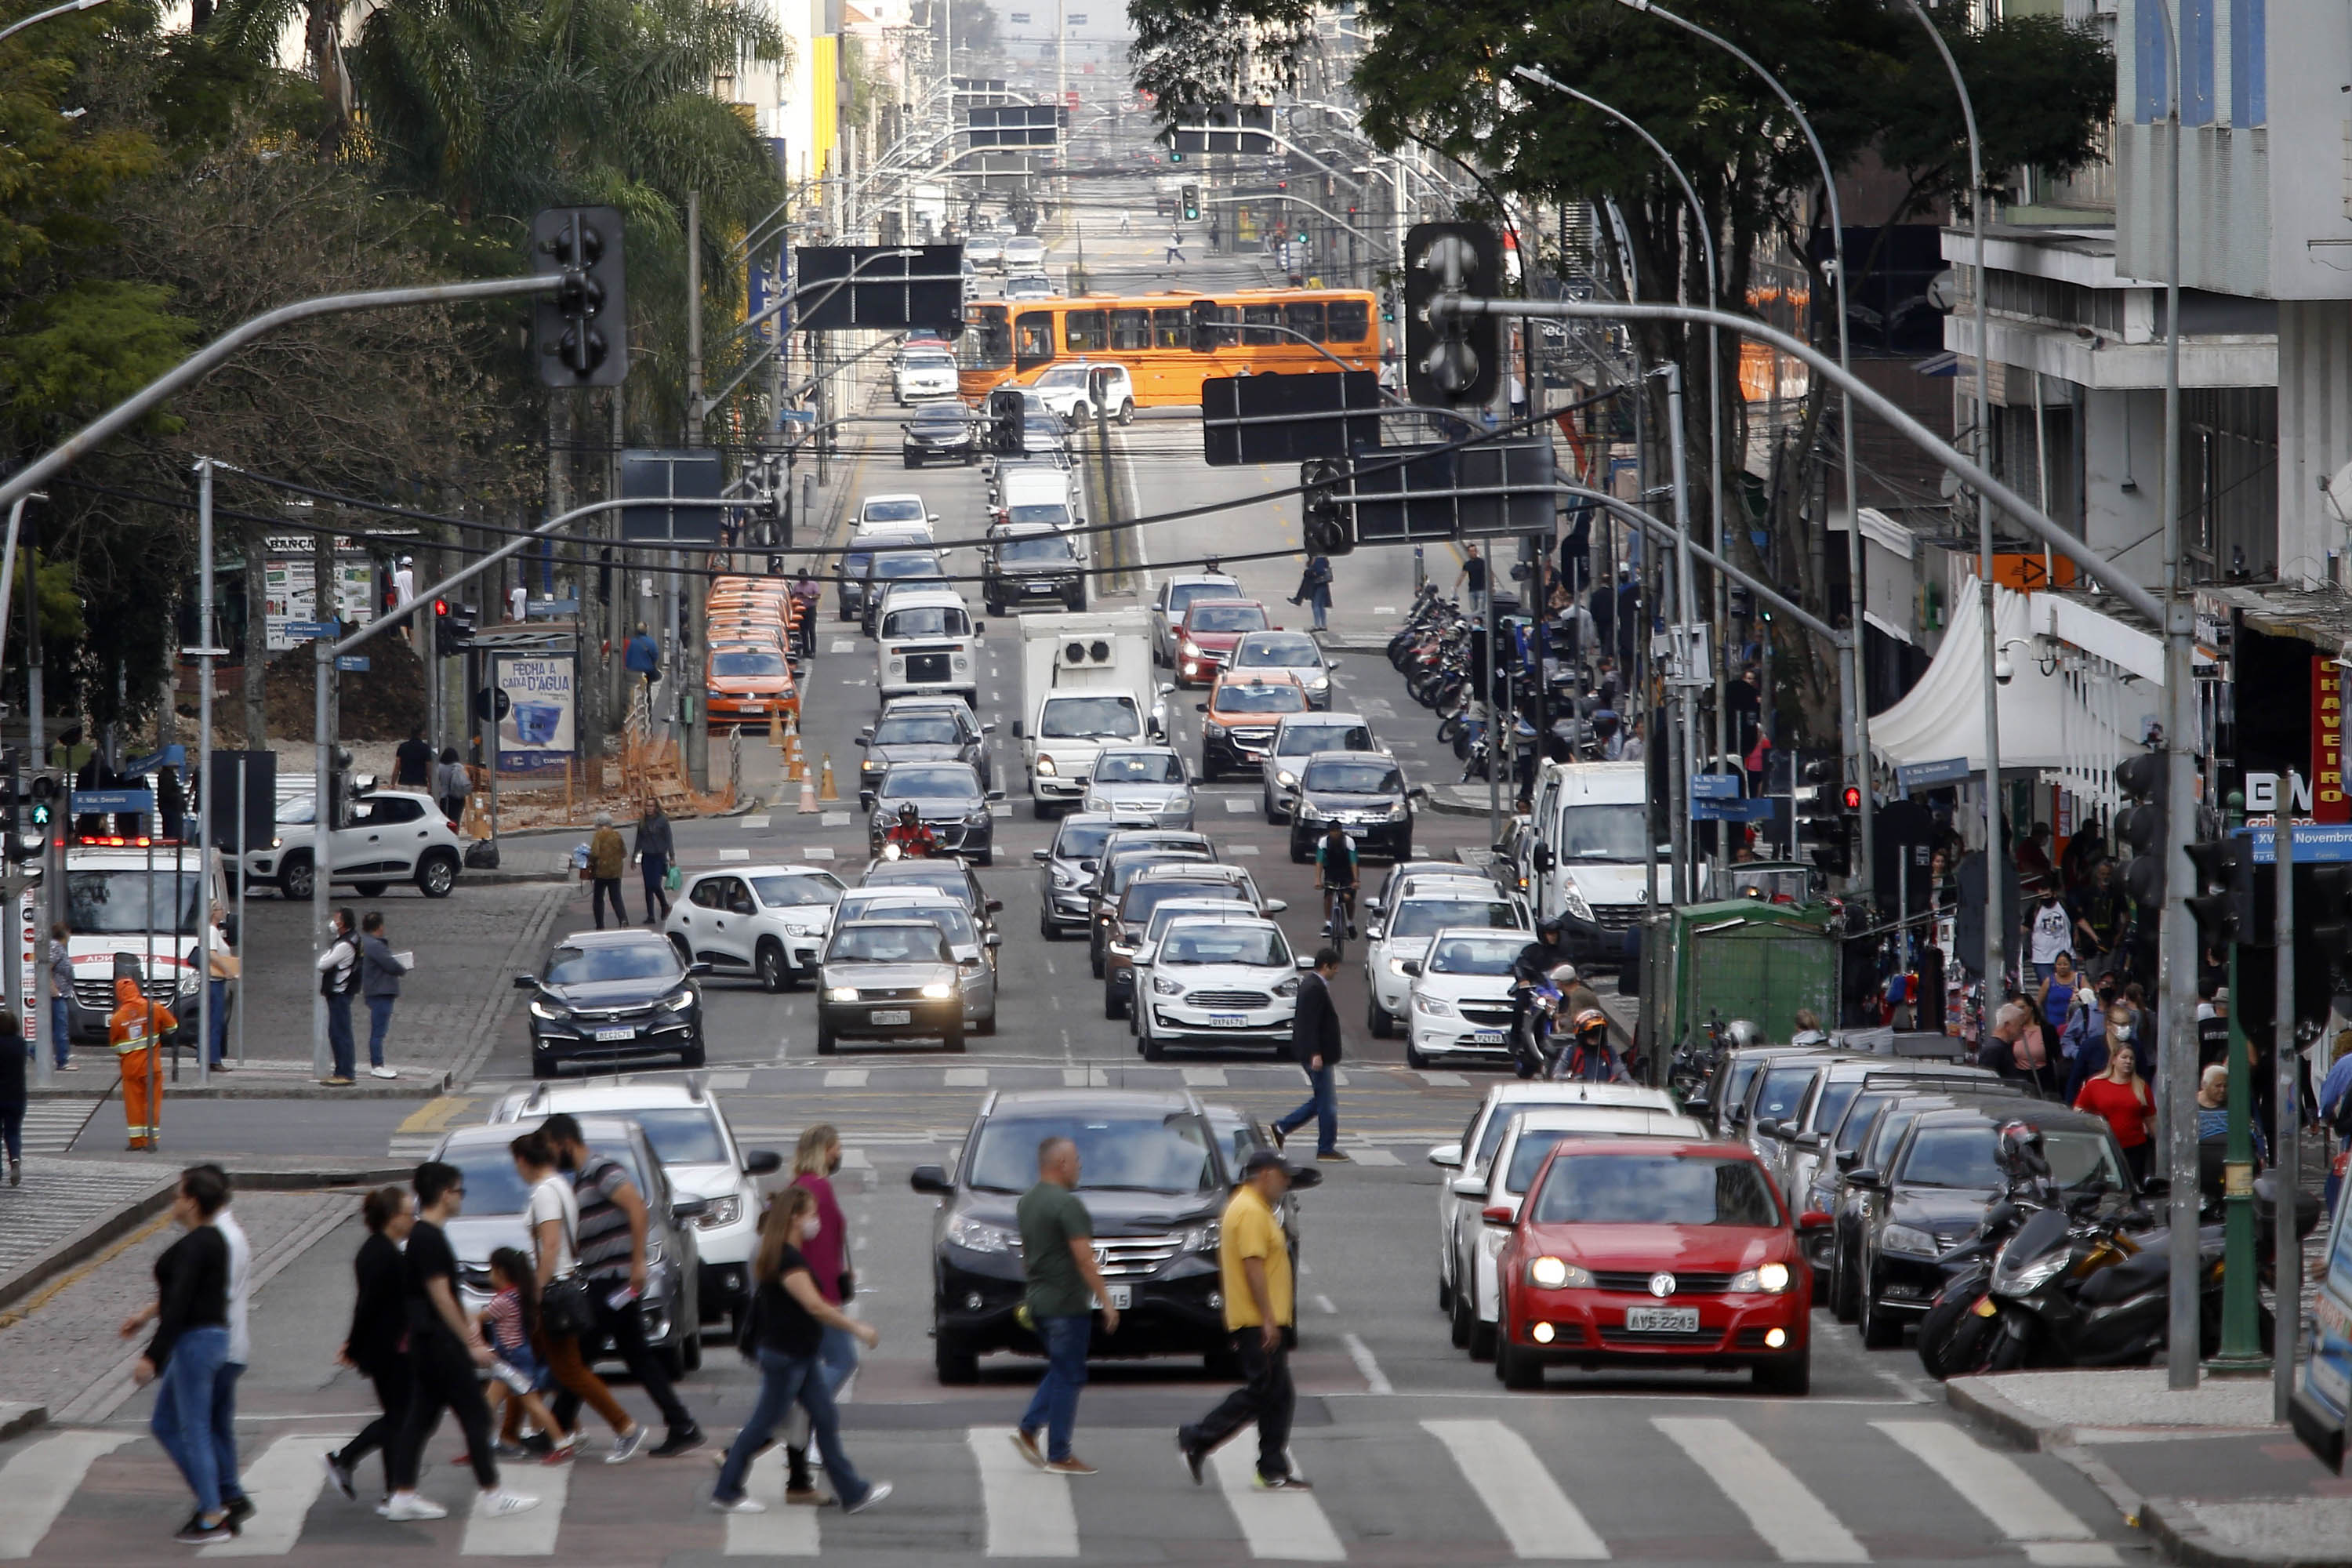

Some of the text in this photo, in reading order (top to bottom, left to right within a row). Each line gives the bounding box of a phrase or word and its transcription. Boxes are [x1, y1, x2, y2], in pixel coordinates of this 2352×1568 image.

[513, 663, 556, 676] FECHA A
[503, 678, 527, 689] CAIXA
[2321, 661, 2343, 802] CHAVEIRO
